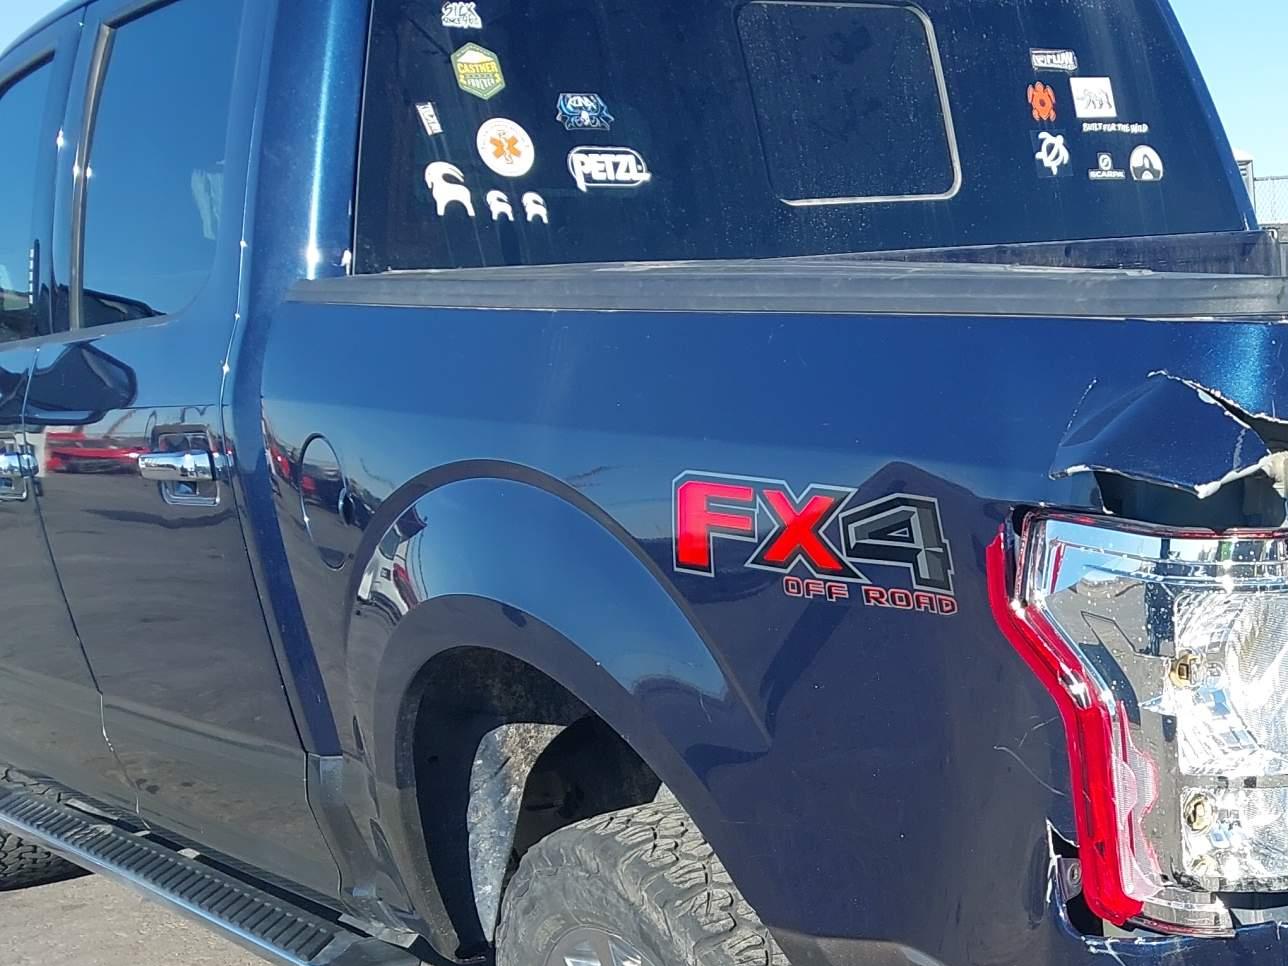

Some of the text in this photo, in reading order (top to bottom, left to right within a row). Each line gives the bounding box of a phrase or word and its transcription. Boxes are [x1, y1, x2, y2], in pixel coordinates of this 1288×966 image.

[574, 153, 650, 192] PETZL
[671, 469, 954, 596] FX4
[783, 576, 958, 615] OFF ROAD
